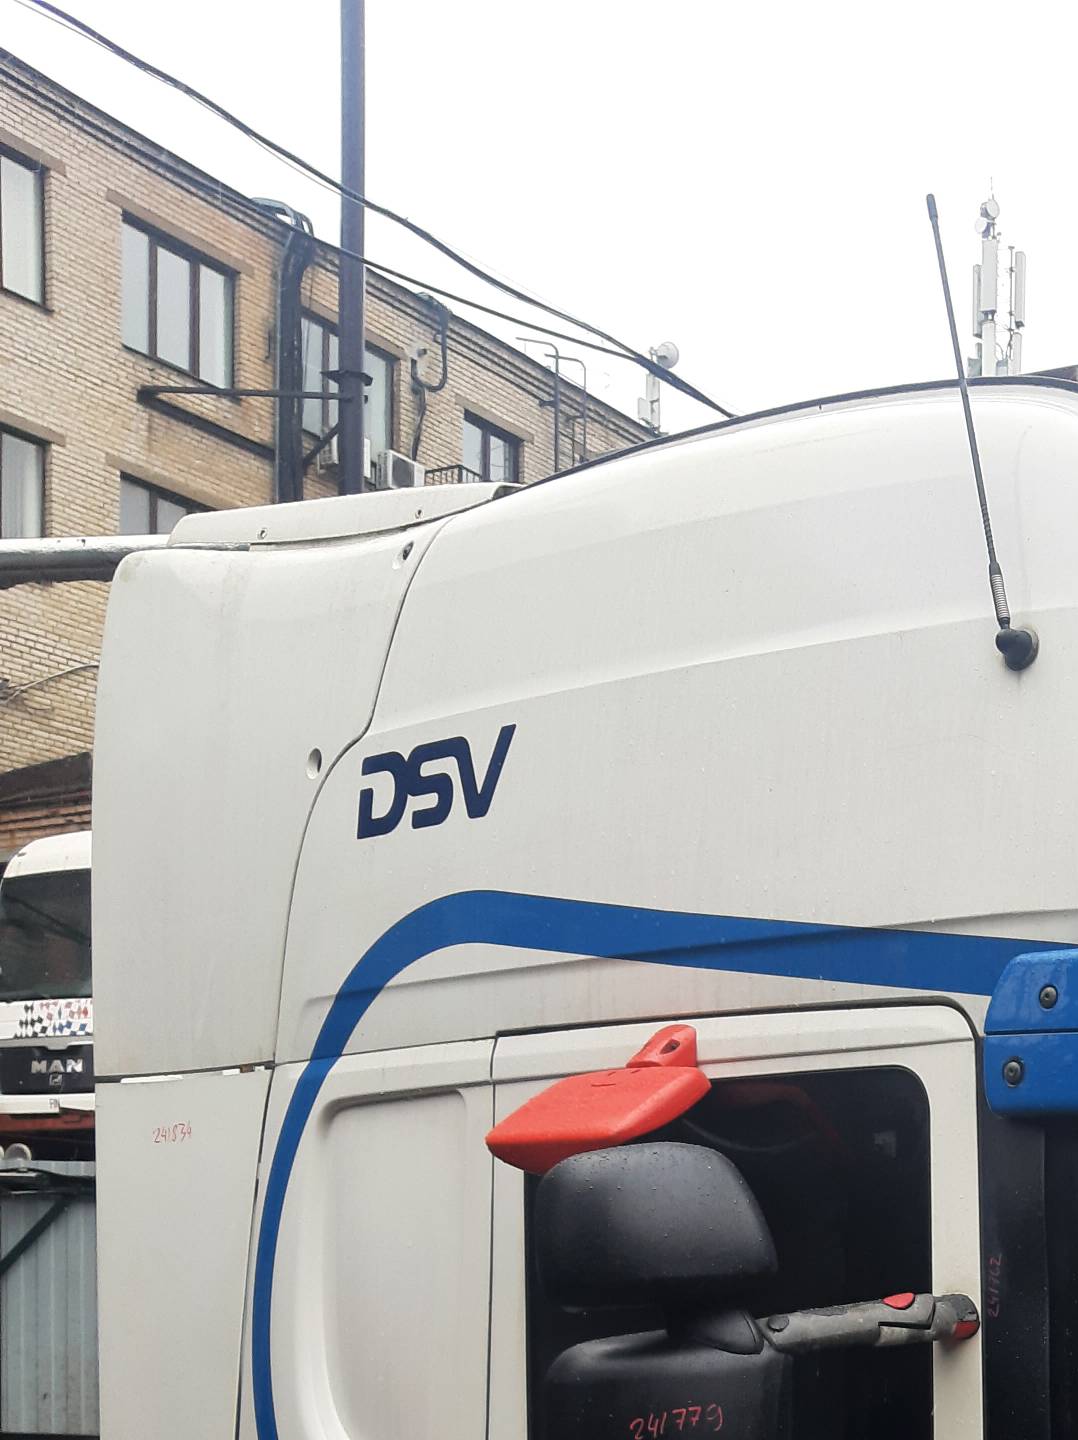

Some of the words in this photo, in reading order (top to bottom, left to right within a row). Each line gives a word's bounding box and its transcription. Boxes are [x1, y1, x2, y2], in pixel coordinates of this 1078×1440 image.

[357, 723, 517, 840] DSV
[31, 1058, 83, 1073] MAN
[629, 1403, 723, 1440] 241779
